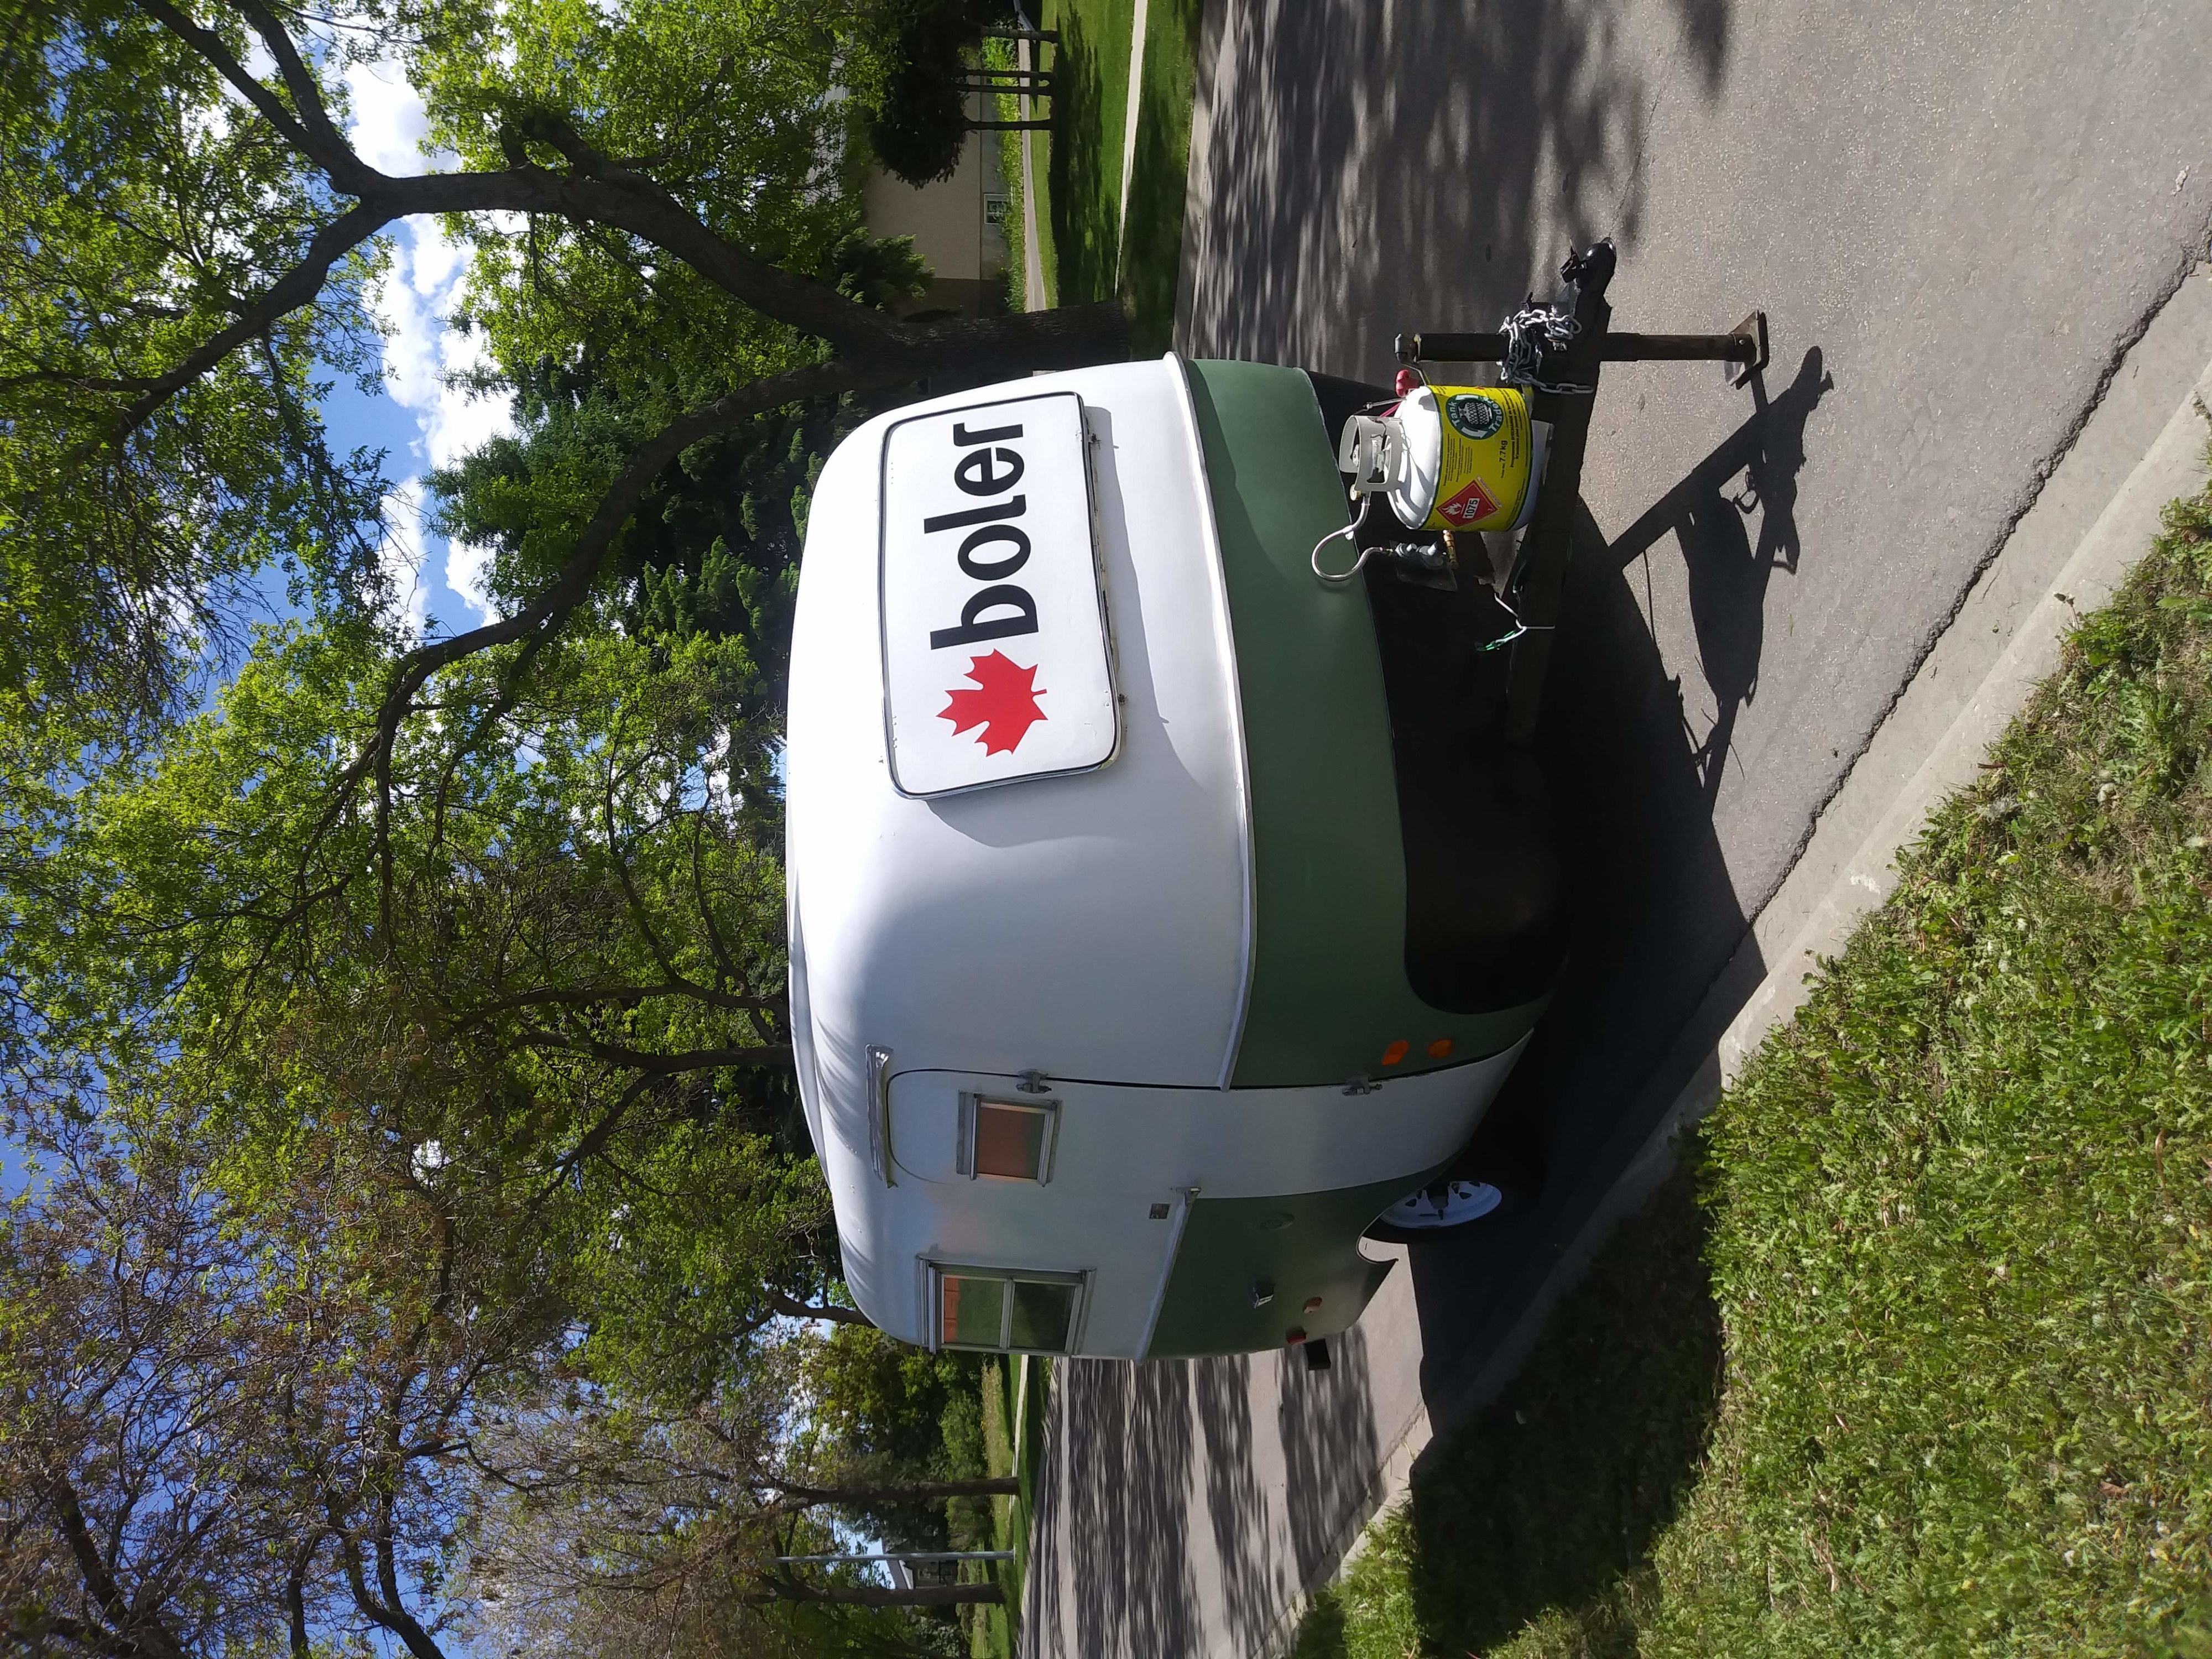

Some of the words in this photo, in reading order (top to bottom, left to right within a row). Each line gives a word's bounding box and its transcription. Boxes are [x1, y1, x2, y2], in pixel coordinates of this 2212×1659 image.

[1448, 401, 1460, 426] Tank
[1483, 397, 1503, 432] Traders
[1464, 500, 1478, 518] 1075
[923, 423, 1039, 650] boler
